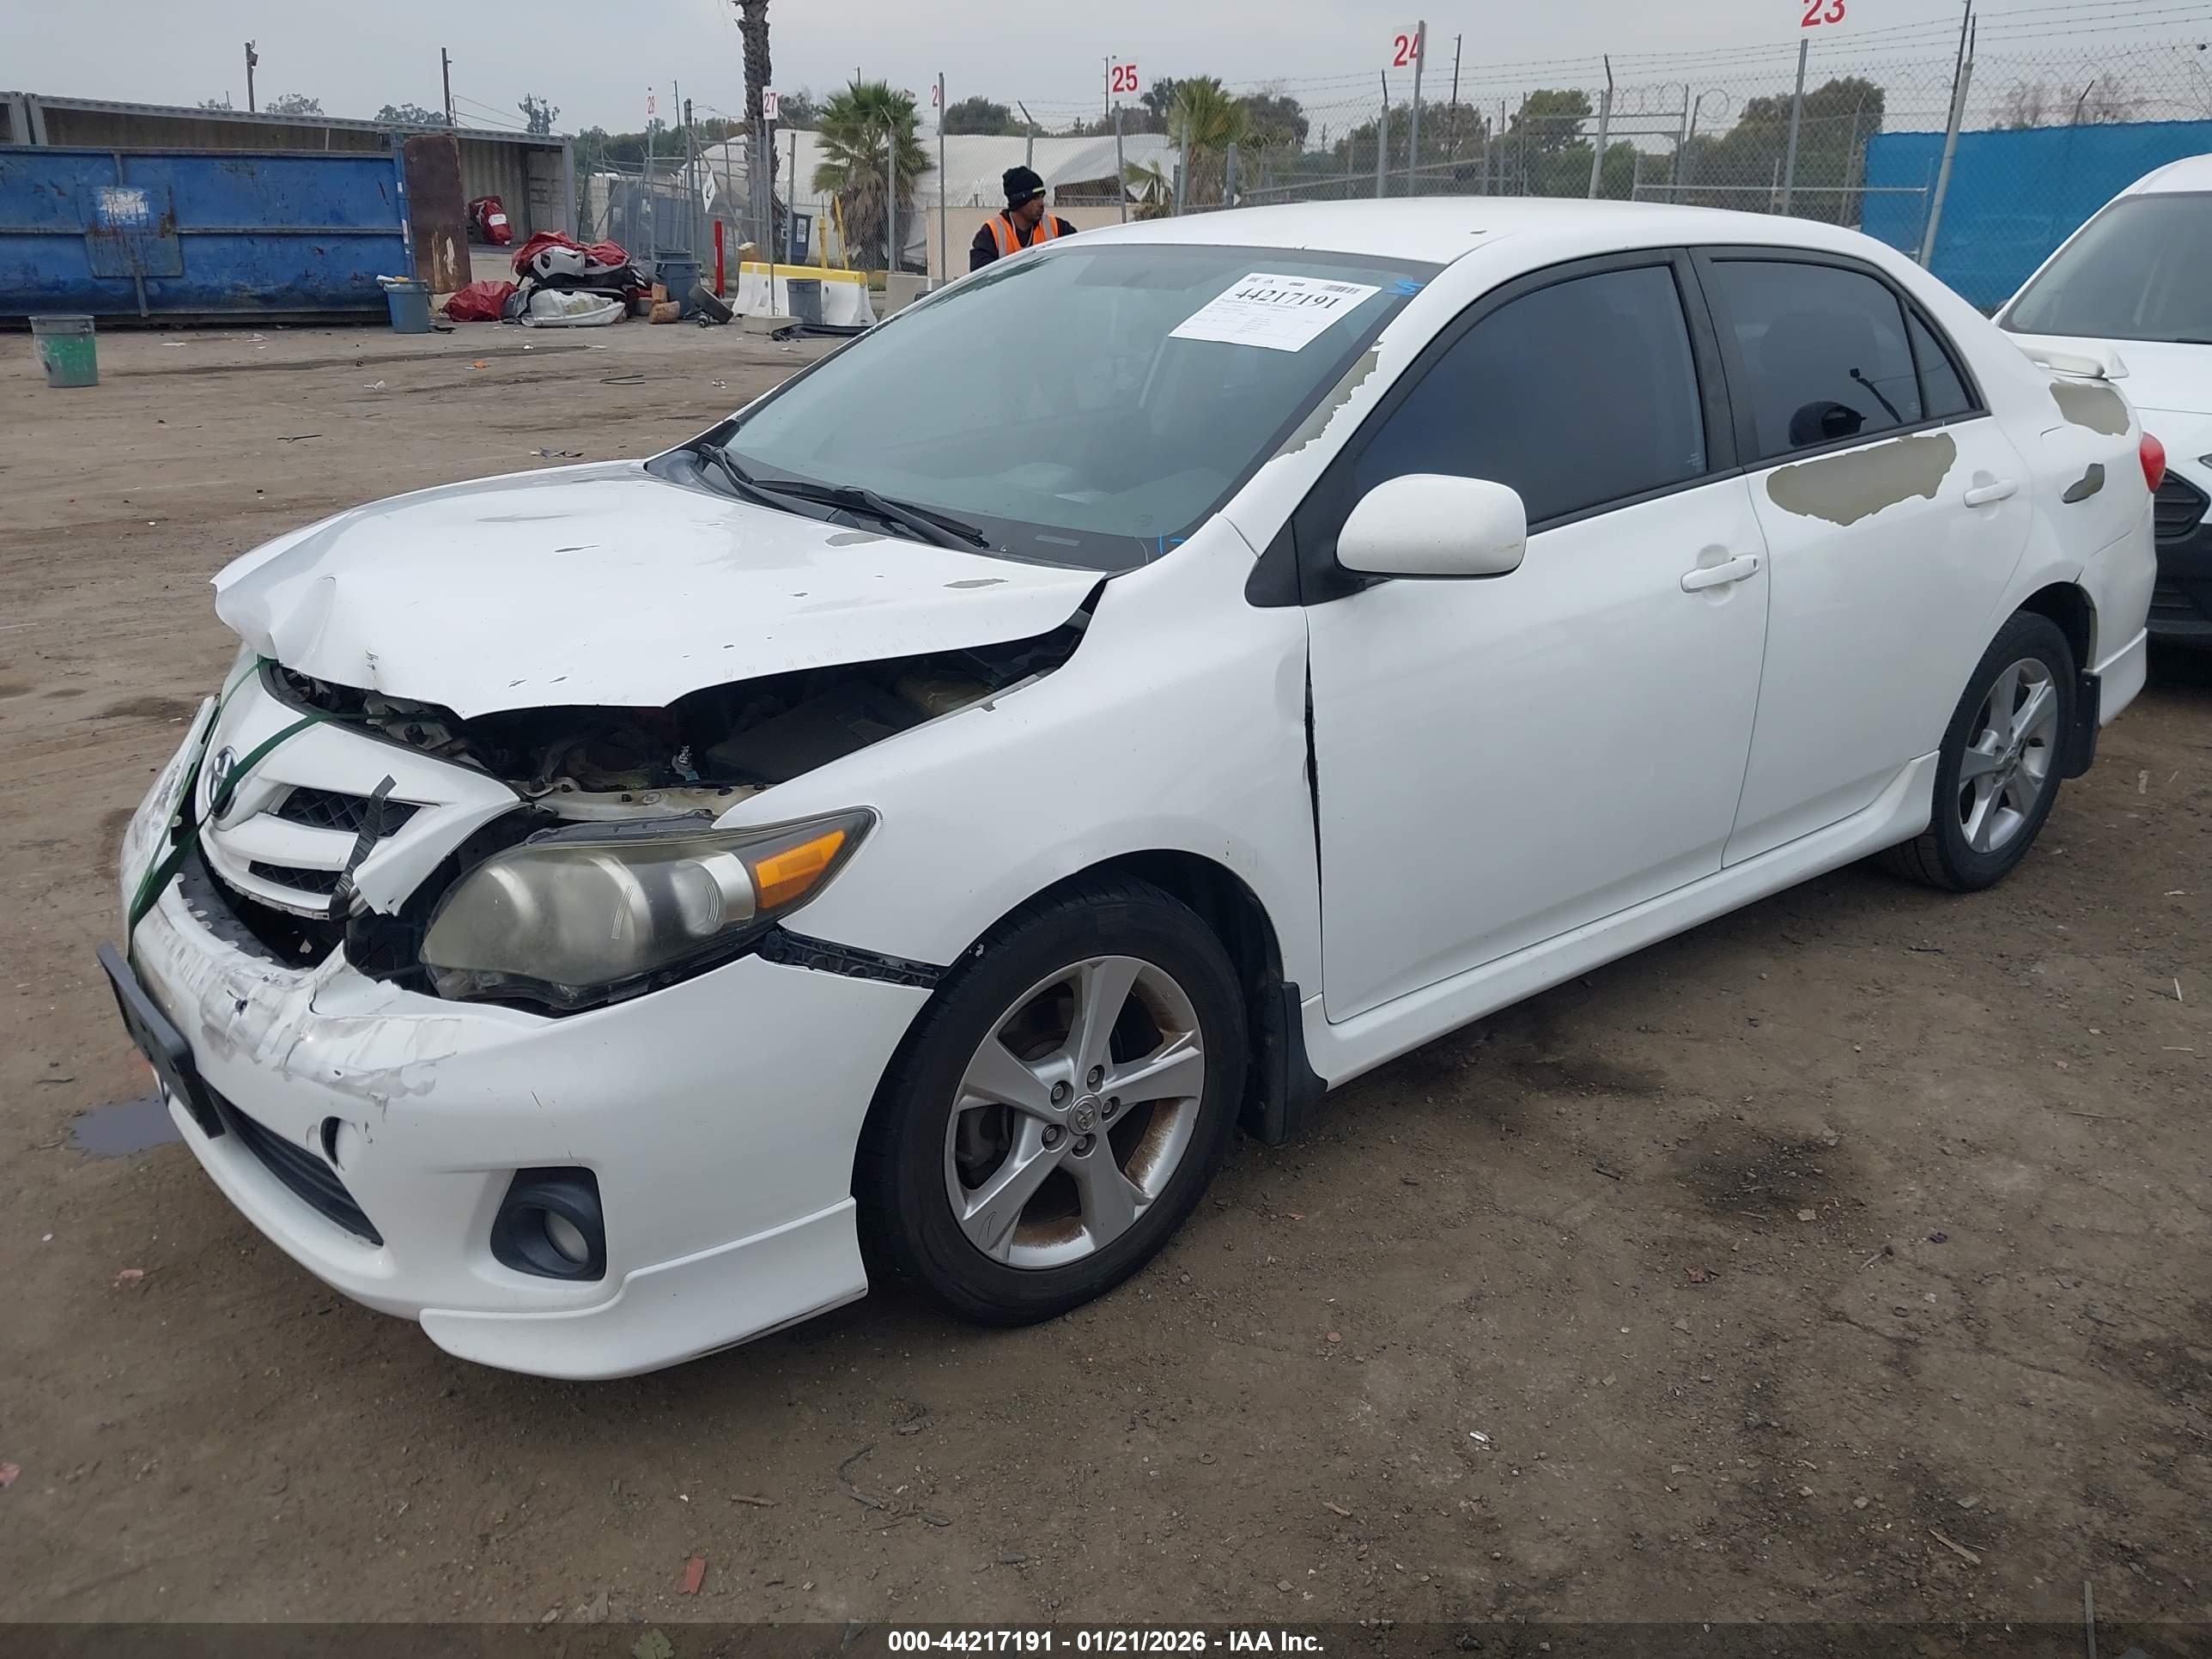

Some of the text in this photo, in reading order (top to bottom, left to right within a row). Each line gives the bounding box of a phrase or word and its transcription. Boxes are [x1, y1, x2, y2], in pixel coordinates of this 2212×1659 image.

[1802, 0, 1846, 27] 23
[1112, 64, 1139, 94] 25
[647, 95, 655, 114] 28
[763, 92, 777, 113] 27
[1234, 288, 1342, 309] 44217191
